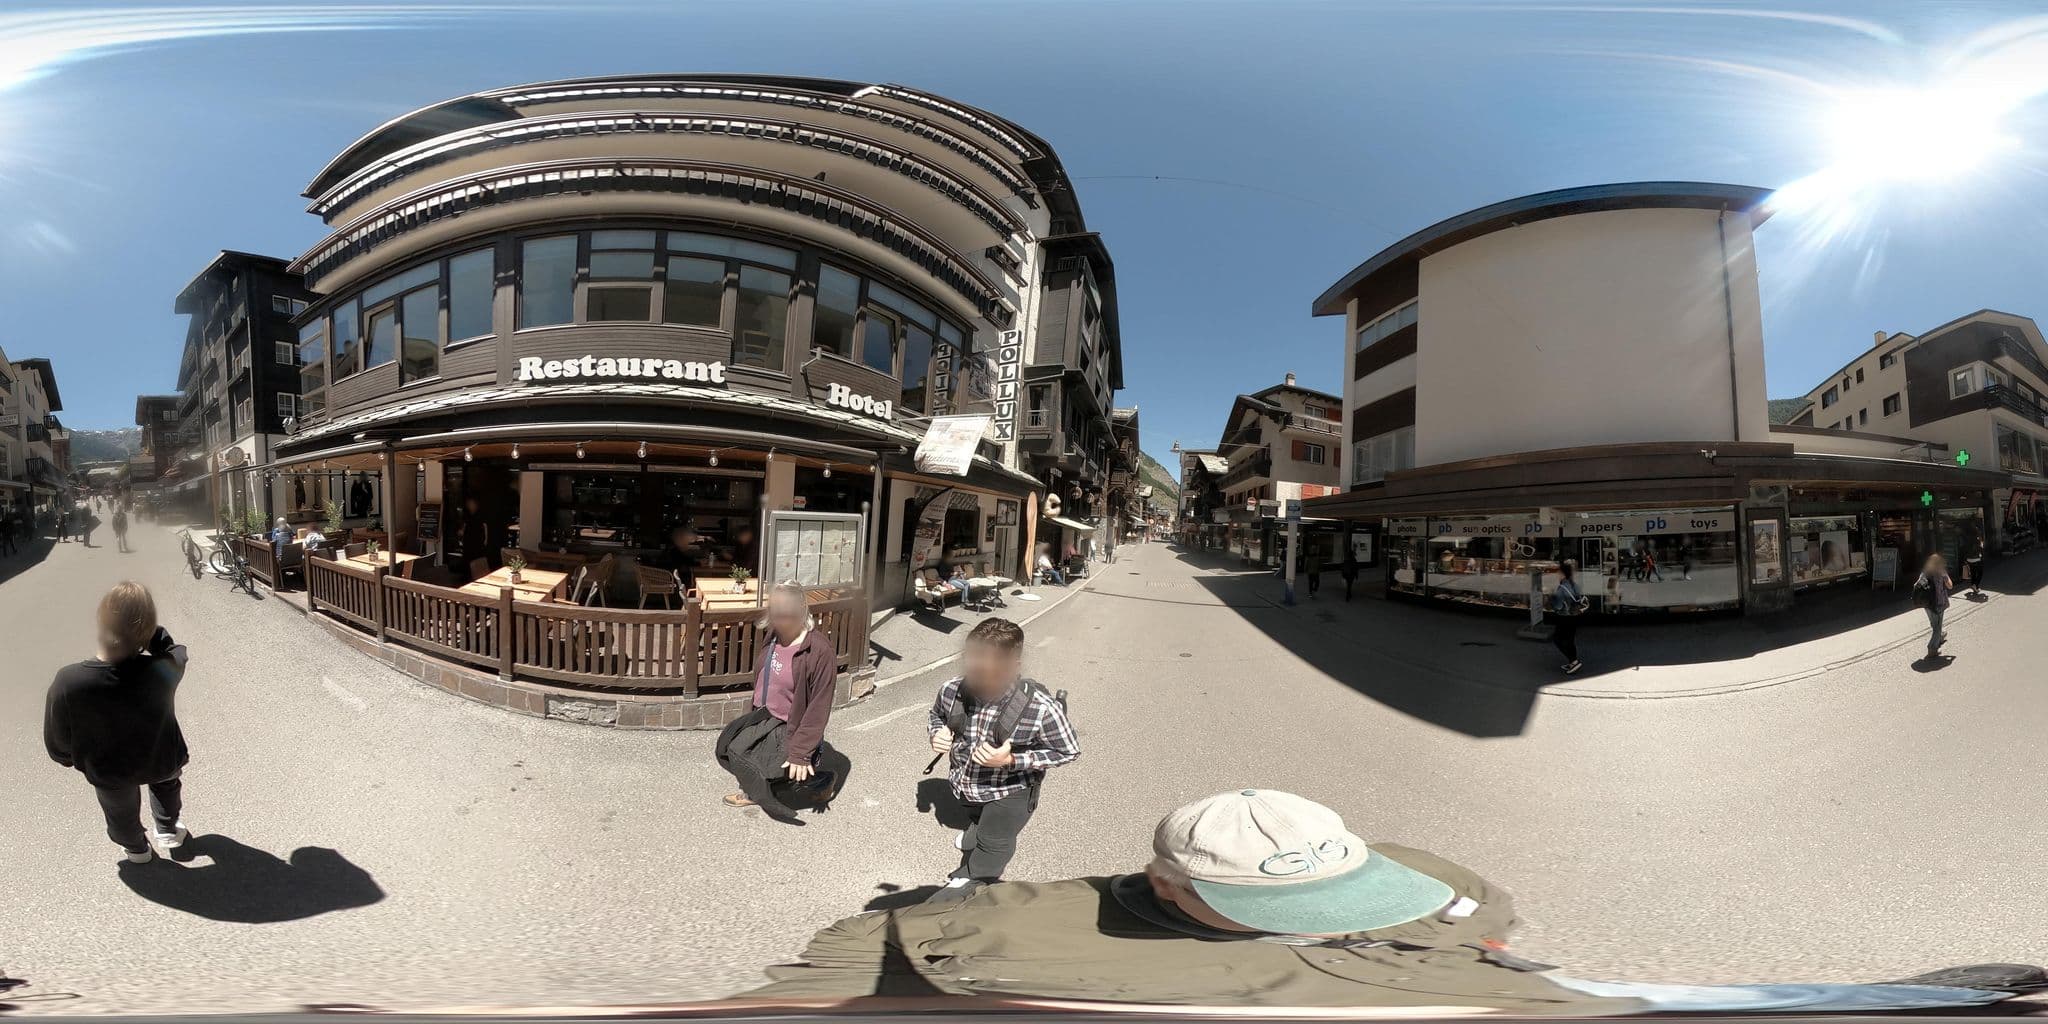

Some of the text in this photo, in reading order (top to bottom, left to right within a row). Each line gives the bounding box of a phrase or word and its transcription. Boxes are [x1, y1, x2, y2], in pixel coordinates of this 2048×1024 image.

[518, 354, 726, 385] Restaurant
[995, 331, 1017, 439] POLLUX
[826, 382, 892, 420] Hotel
[1397, 525, 1417, 534] photo
[1438, 523, 1453, 534] pb
[1481, 524, 1512, 535] optics
[1524, 522, 1543, 536] pb
[1580, 522, 1623, 534] papers
[1646, 516, 1667, 532] pb
[1690, 518, 1718, 530] toys
